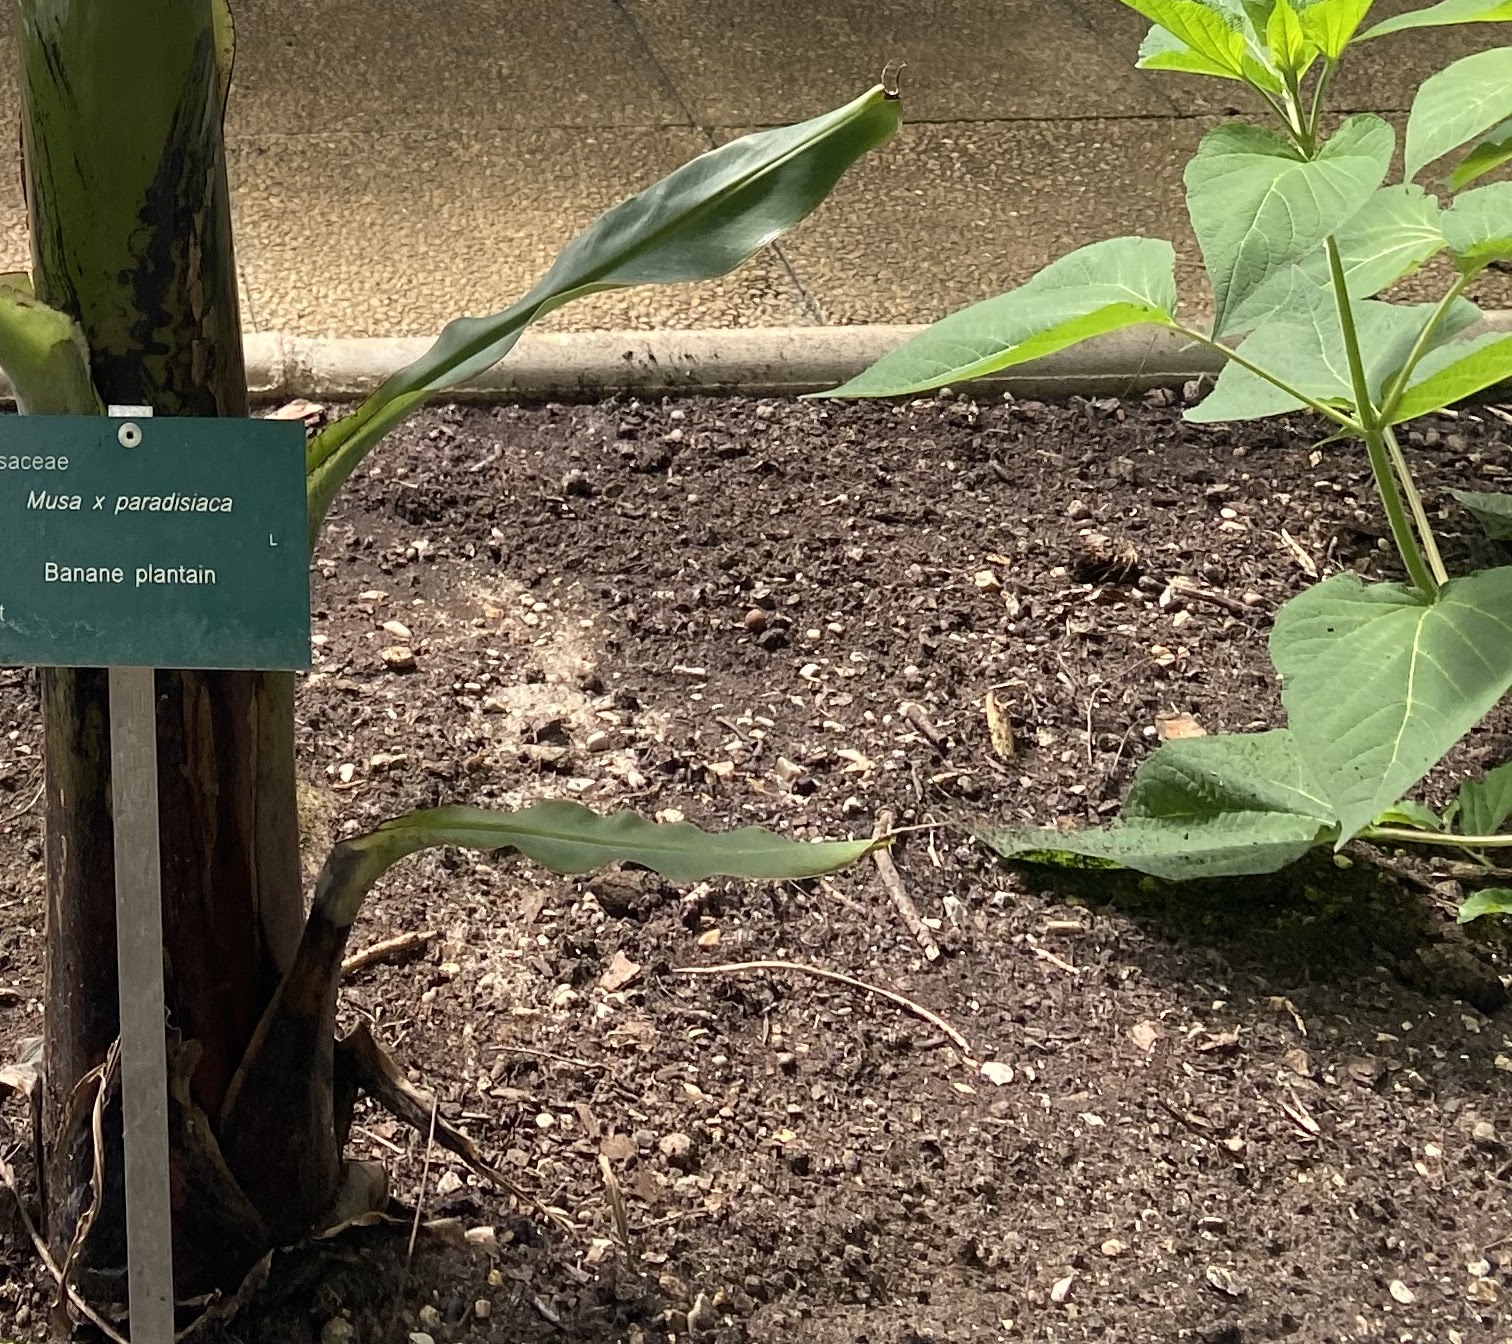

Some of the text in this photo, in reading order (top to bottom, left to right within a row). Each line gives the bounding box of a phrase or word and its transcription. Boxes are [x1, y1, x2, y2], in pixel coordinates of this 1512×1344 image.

[26, 490, 233, 516] Musa x paradisiaca
[44, 561, 216, 588] Banane plantain
